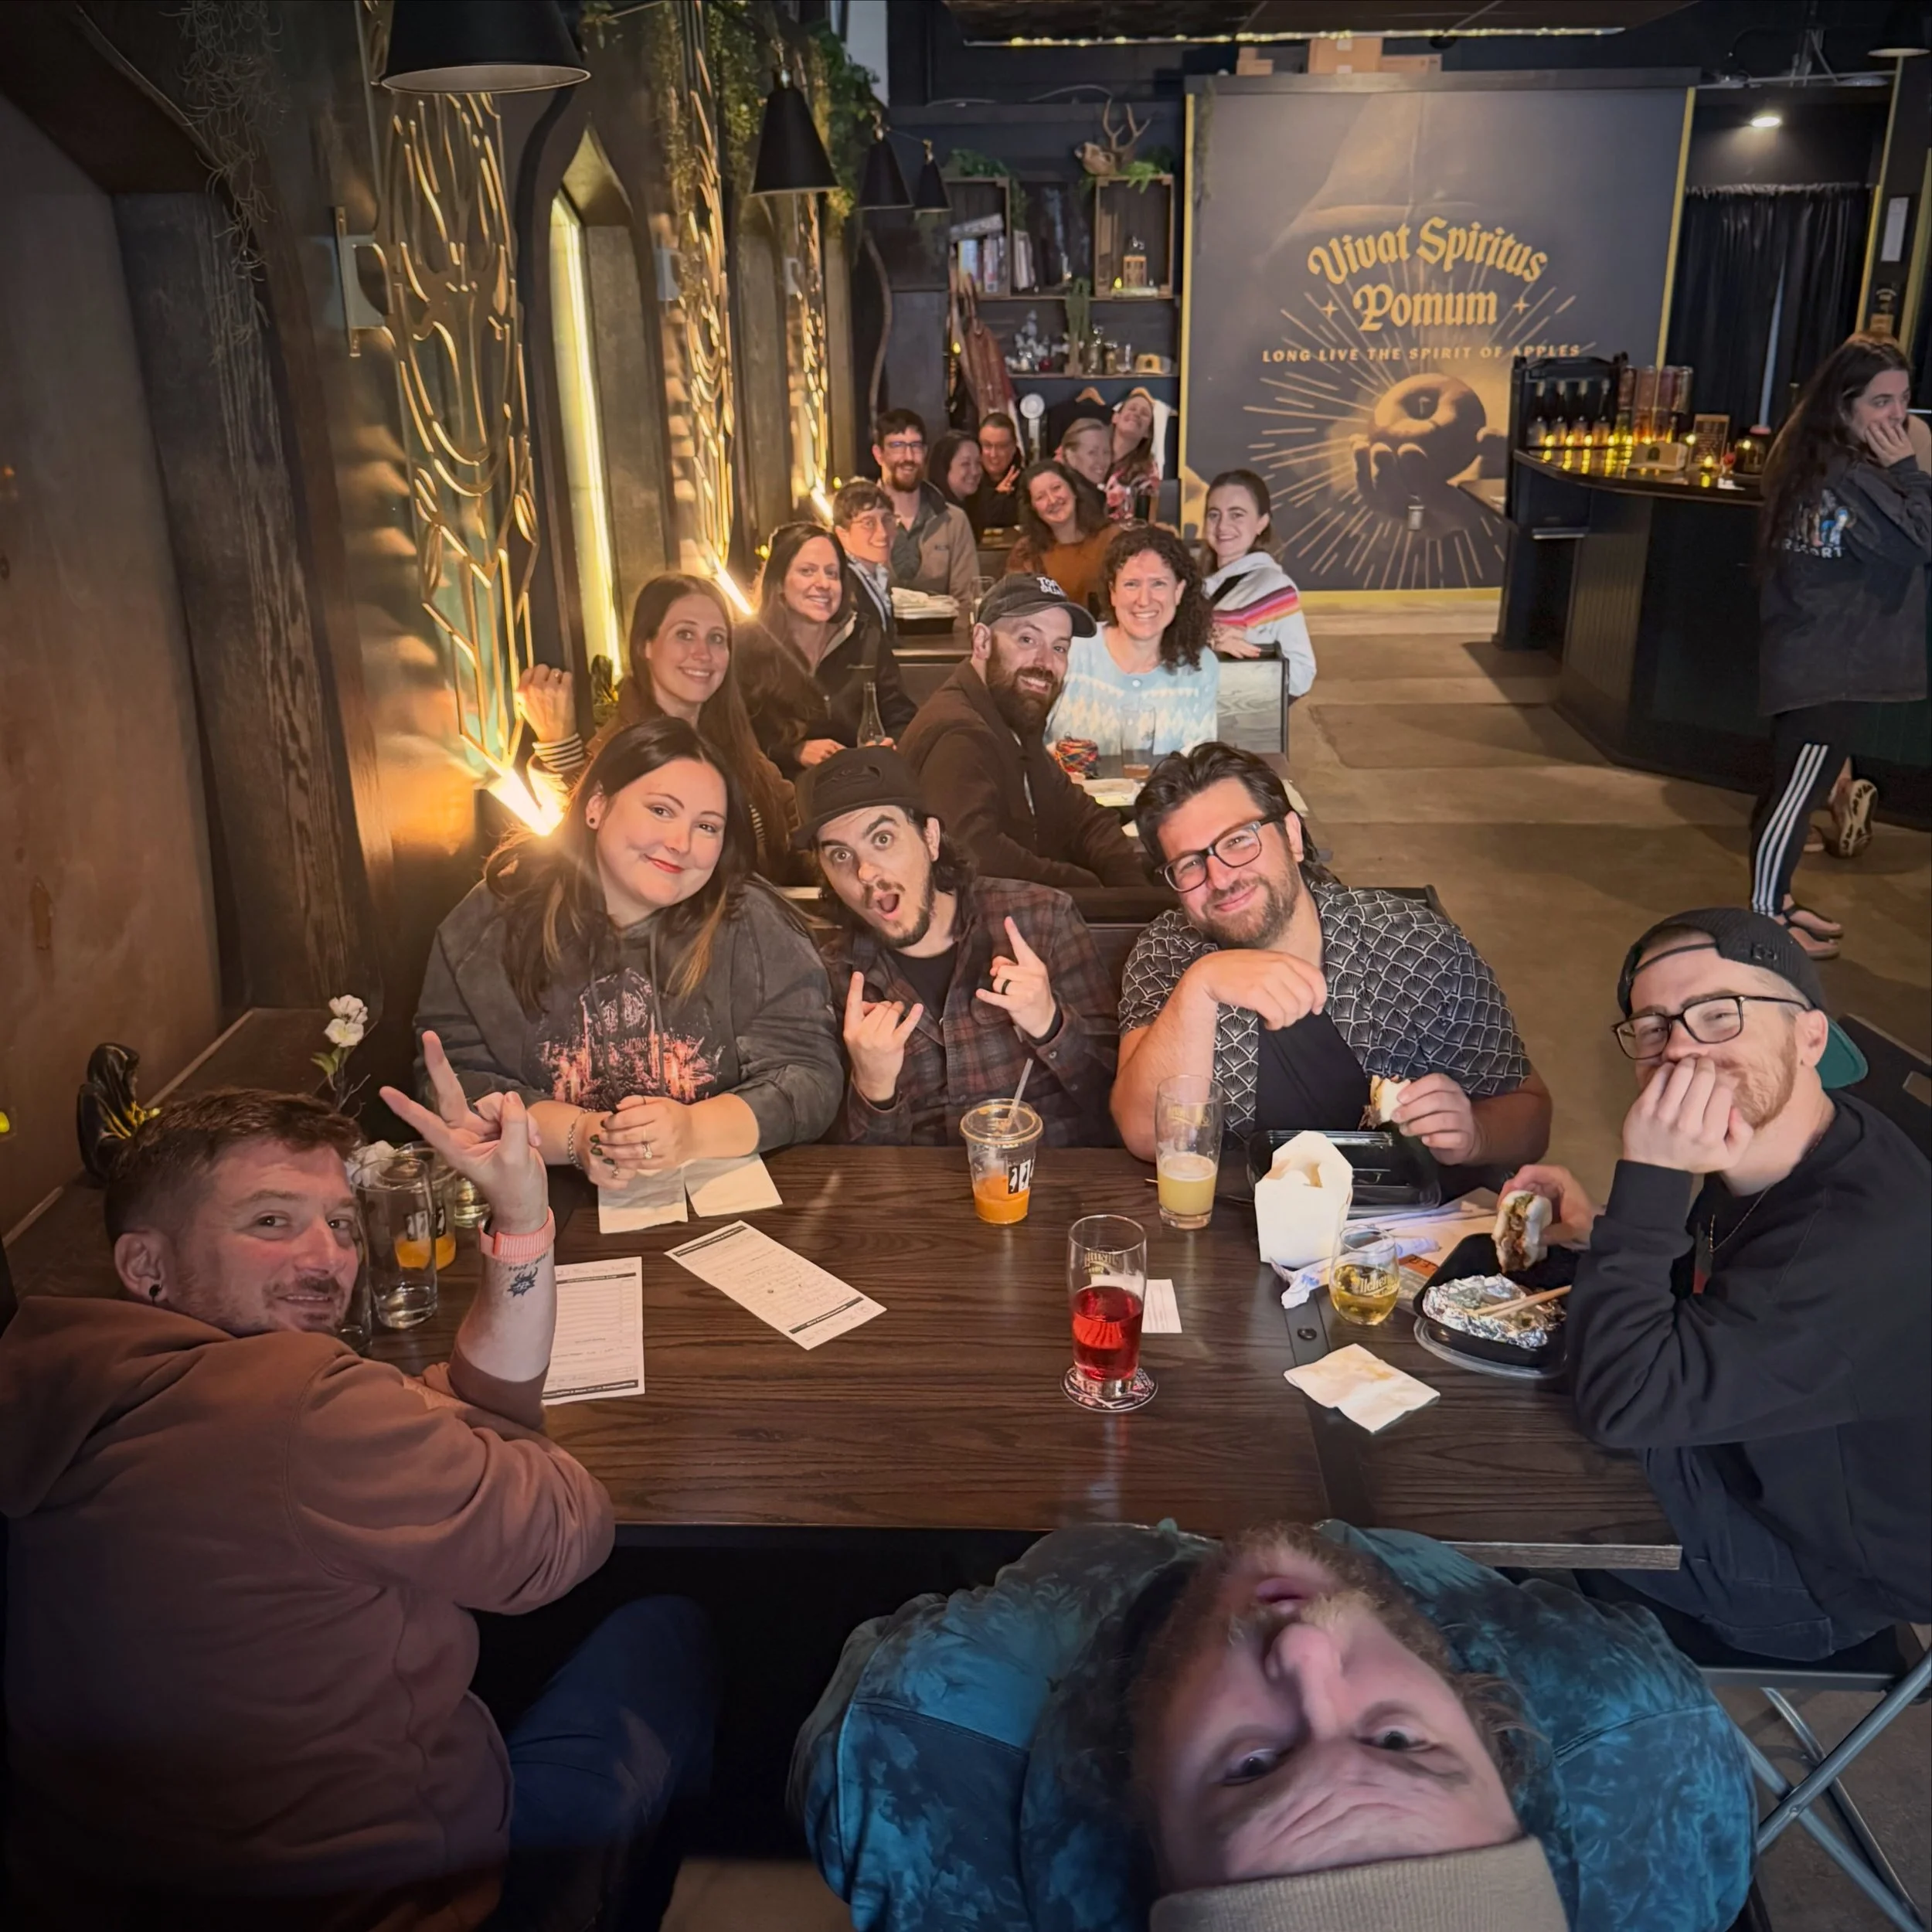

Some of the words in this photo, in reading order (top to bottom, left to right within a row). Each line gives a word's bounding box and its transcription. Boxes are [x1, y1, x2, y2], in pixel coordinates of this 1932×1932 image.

[1307, 223, 1411, 285] Vivat
[1415, 216, 1549, 283] Spiritus
[1352, 283, 1498, 332] Pomum
[1262, 349, 1311, 362] LONG
[1318, 349, 1359, 362] LIVE
[1367, 348, 1402, 361] THE
[1409, 347, 1471, 360] SPIRIT
[1479, 346, 1503, 359] OF
[1512, 344, 1580, 358] APPLES
